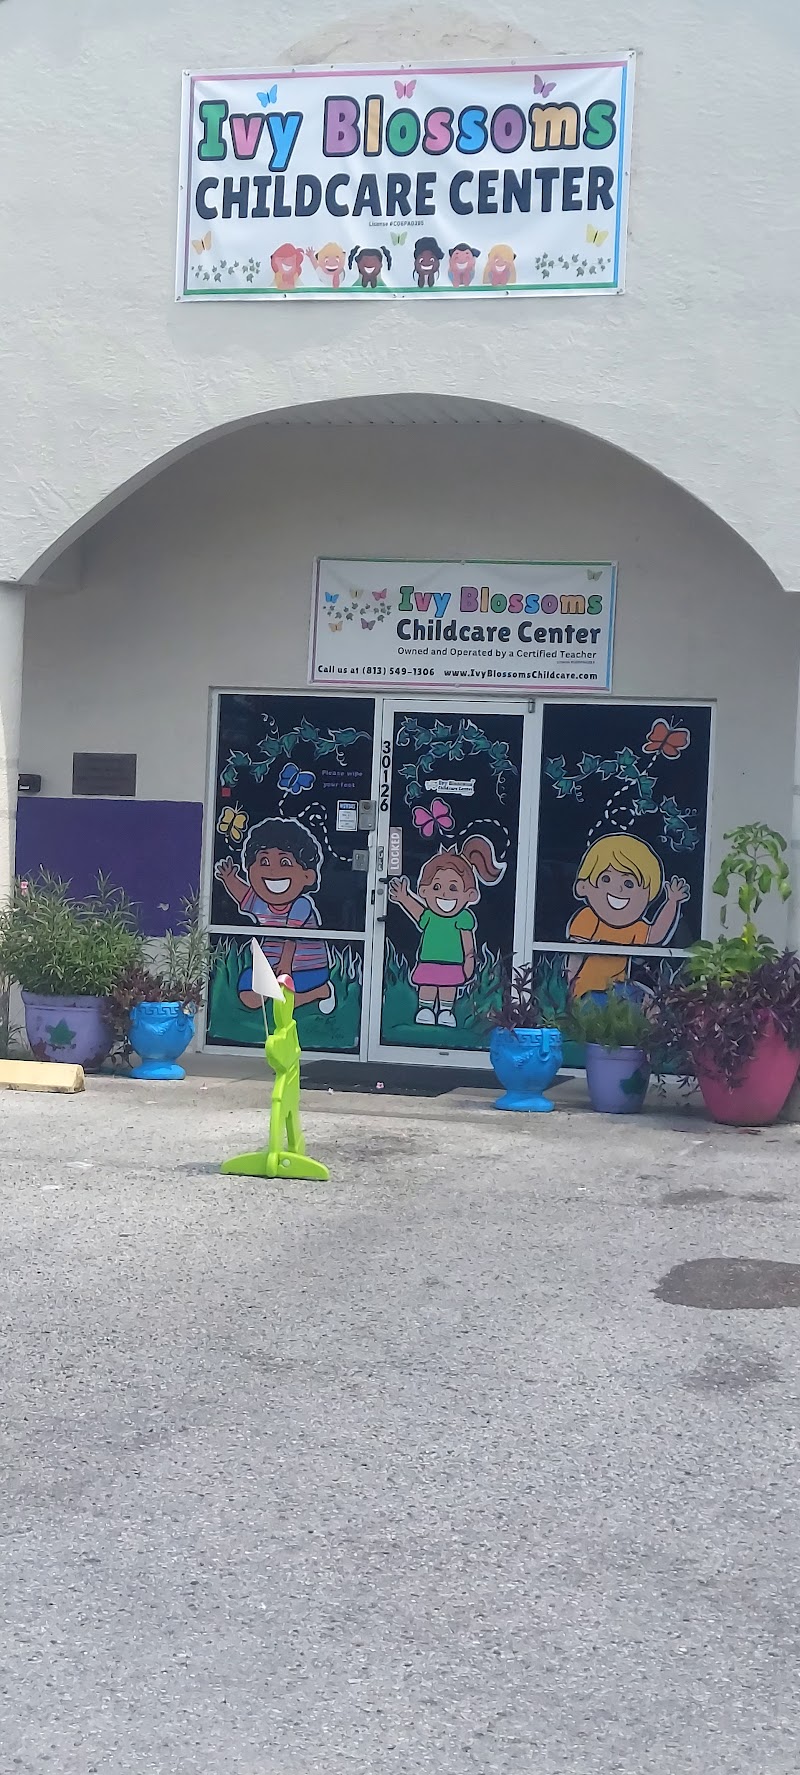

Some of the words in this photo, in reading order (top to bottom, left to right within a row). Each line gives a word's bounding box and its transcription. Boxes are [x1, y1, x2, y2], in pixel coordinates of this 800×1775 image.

[198, 99, 303, 172] Ivy
[322, 94, 616, 158] Blossoms
[195, 171, 437, 219] CHILDCARE
[449, 165, 615, 215] CENTER
[398, 585, 451, 618] Ivy
[459, 586, 603, 615] Blossoms
[396, 619, 511, 643] Childcare
[517, 621, 601, 644] Center
[397, 647, 429, 655] Owned
[431, 648, 447, 656] and
[450, 648, 493, 658] Operated
[495, 649, 506, 659] by
[516, 649, 558, 658] Certified
[560, 650, 597, 659] Teacher
[317, 665, 335, 673] Call
[350, 666, 359, 674] at
[362, 666, 386, 676] (813)
[389, 667, 435, 676] 549-1306
[443, 668, 598, 680] www.IvyBlossomsChildcare.com
[379, 740, 392, 812] 30126
[390, 833, 400, 870] LOCKED
